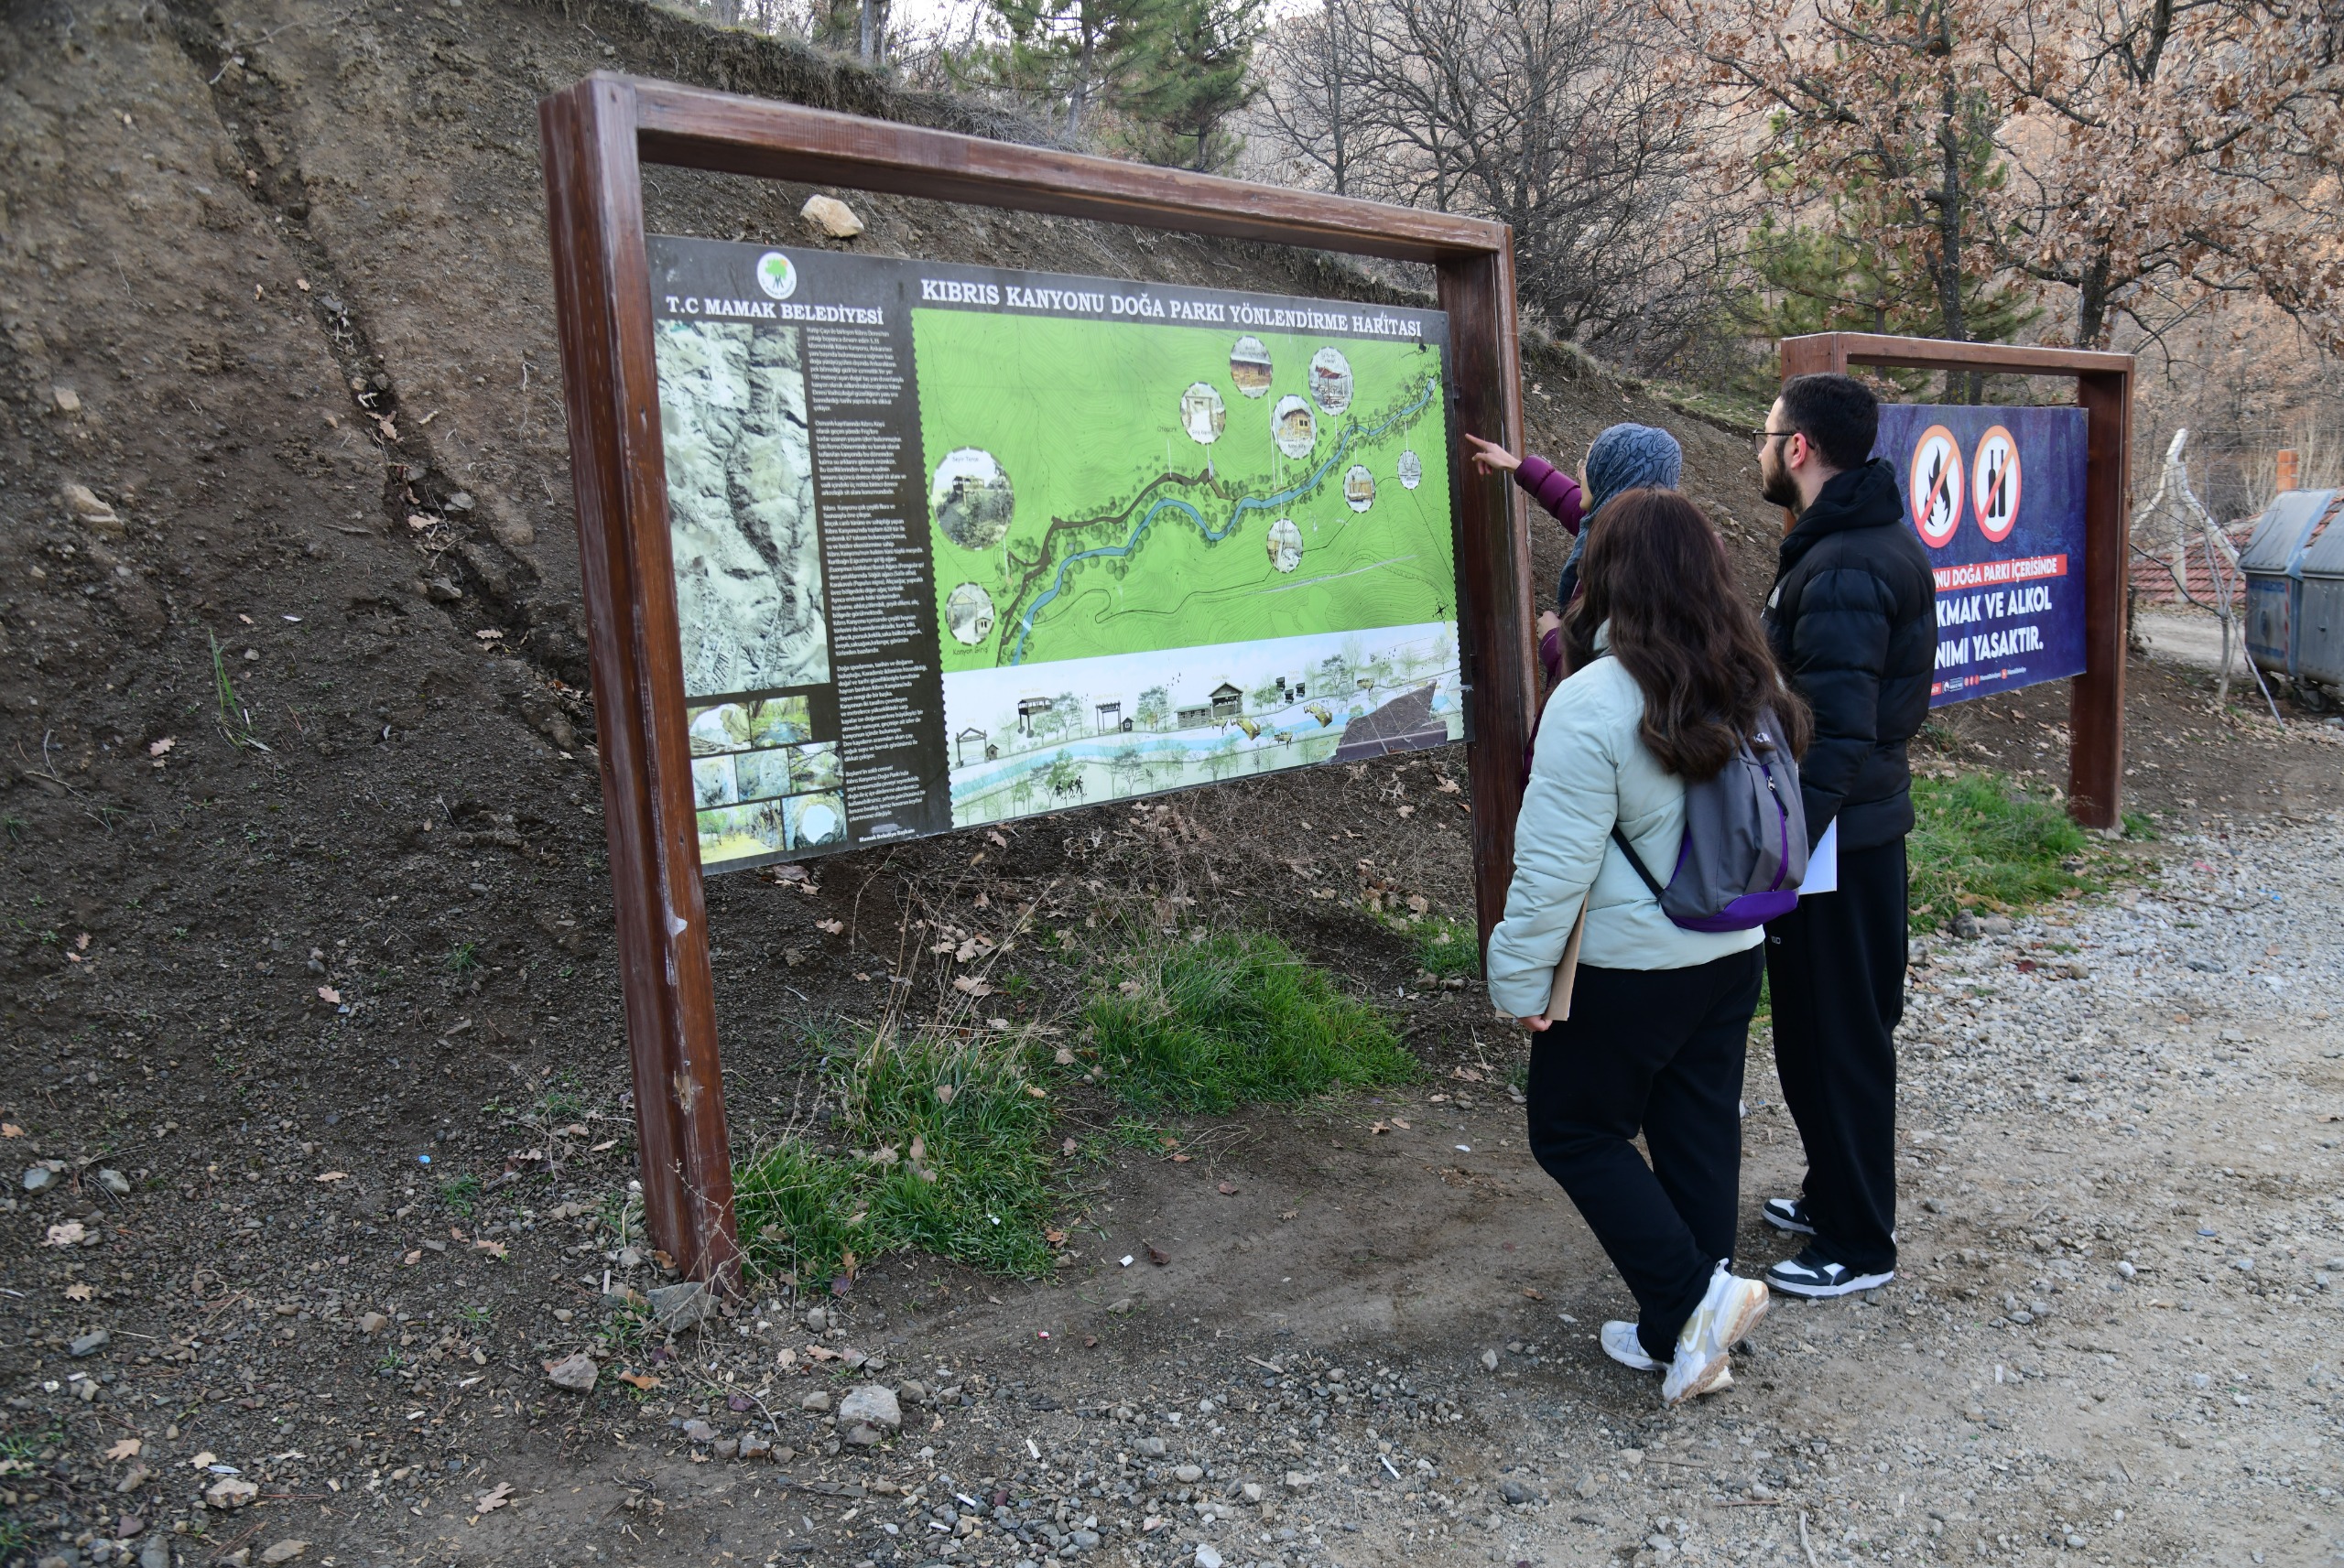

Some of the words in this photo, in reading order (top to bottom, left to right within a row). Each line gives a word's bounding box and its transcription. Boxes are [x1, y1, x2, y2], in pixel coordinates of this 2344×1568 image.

[666, 295, 699, 313] T.C
[704, 298, 776, 319] MAMAK
[780, 302, 884, 325] BELEDİYESİ
[920, 278, 1000, 305] KIBRIS
[1005, 286, 1105, 312] KANYONU
[1111, 293, 1166, 318] DOĞA
[1169, 300, 1225, 322] PARKI
[1229, 303, 1348, 331] YÖNLENDİRME
[1352, 315, 1422, 337] HARİTASI
[1933, 570, 1950, 588] NU
[1952, 563, 1981, 587] DOĞA
[1983, 563, 2010, 582] PARKI
[2012, 556, 2057, 583] İÇERİSİNDE
[1936, 595, 1981, 627] KMAK
[1985, 592, 2004, 619] VE
[2007, 586, 2052, 616] ALKOL
[1934, 637, 1969, 670] NIMI
[1972, 625, 2045, 662] YASAKTIR.
[859, 835, 876, 843] Mamak
[877, 830, 896, 840] Belediye
[897, 827, 915, 837] Başkanı
